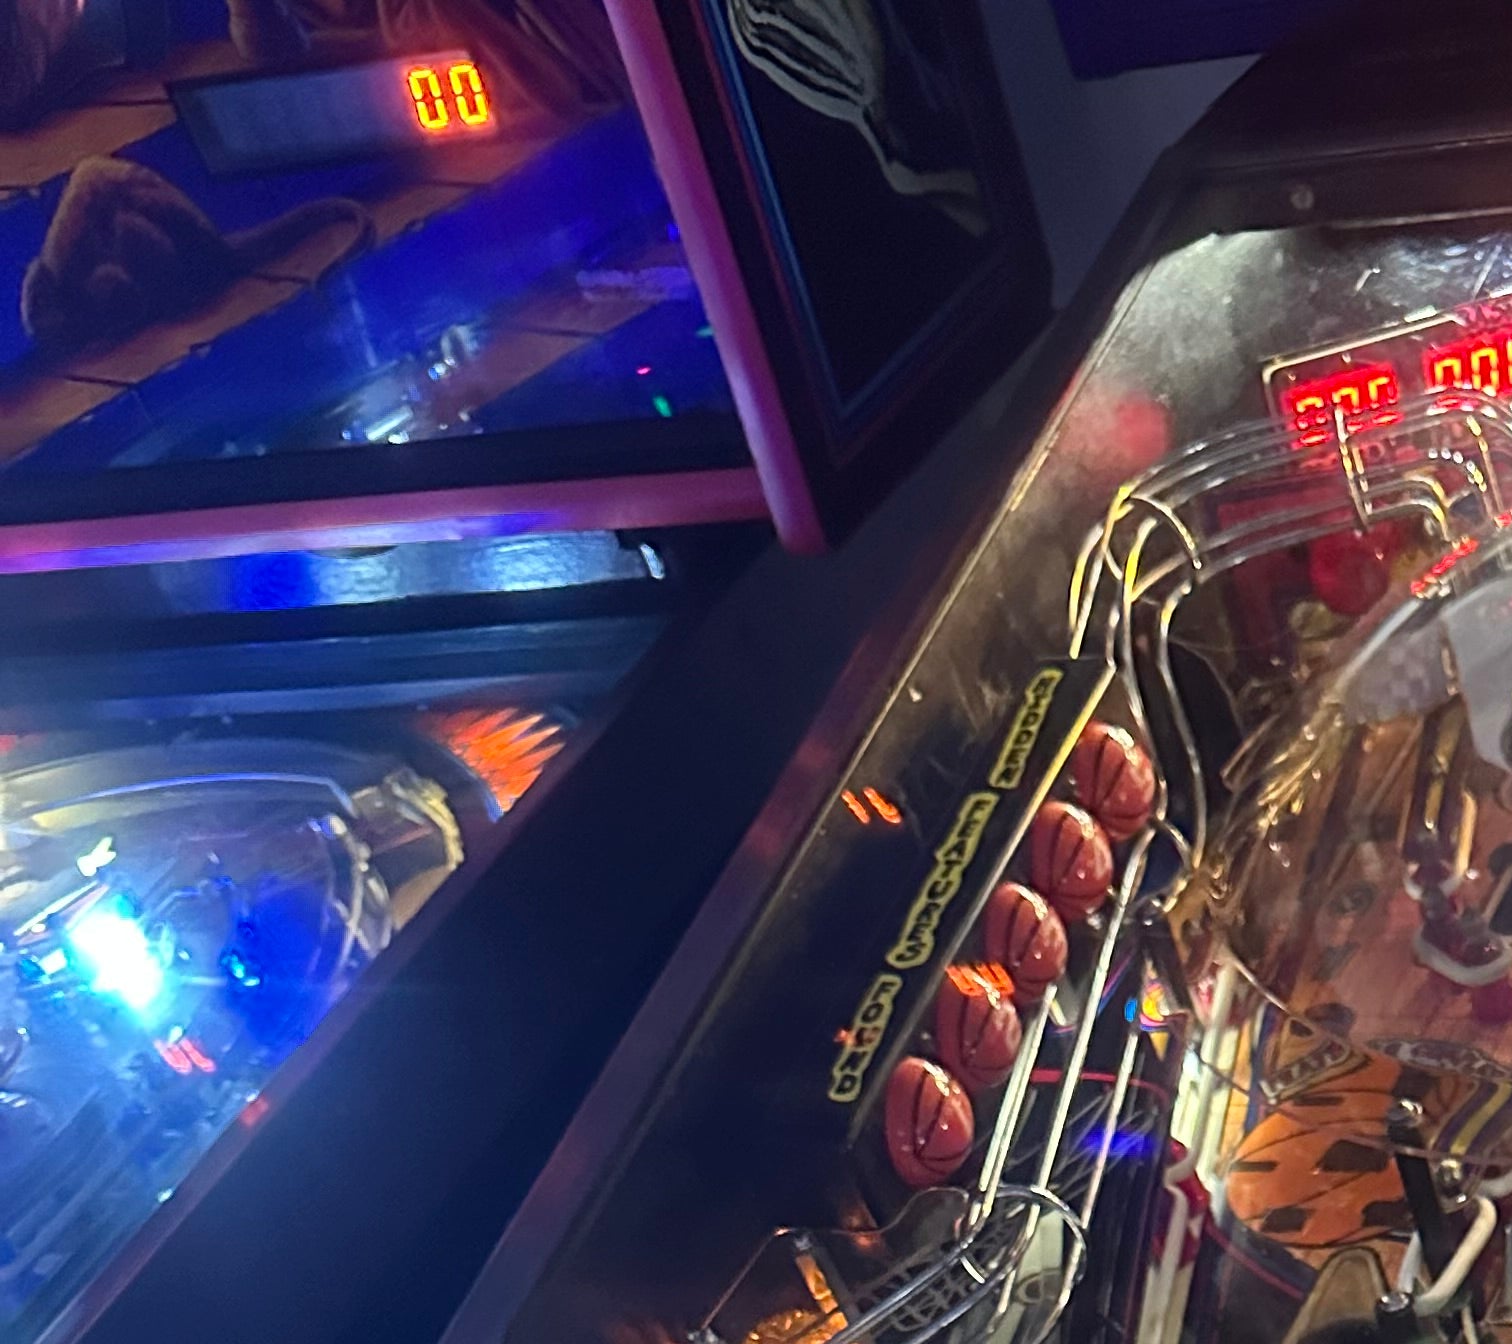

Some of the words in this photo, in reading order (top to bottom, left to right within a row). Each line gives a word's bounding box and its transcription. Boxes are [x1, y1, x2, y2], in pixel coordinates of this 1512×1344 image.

[406, 60, 490, 131] 00
[887, 791, 997, 968] FEATURES
[828, 972, 902, 1102] FOUND
